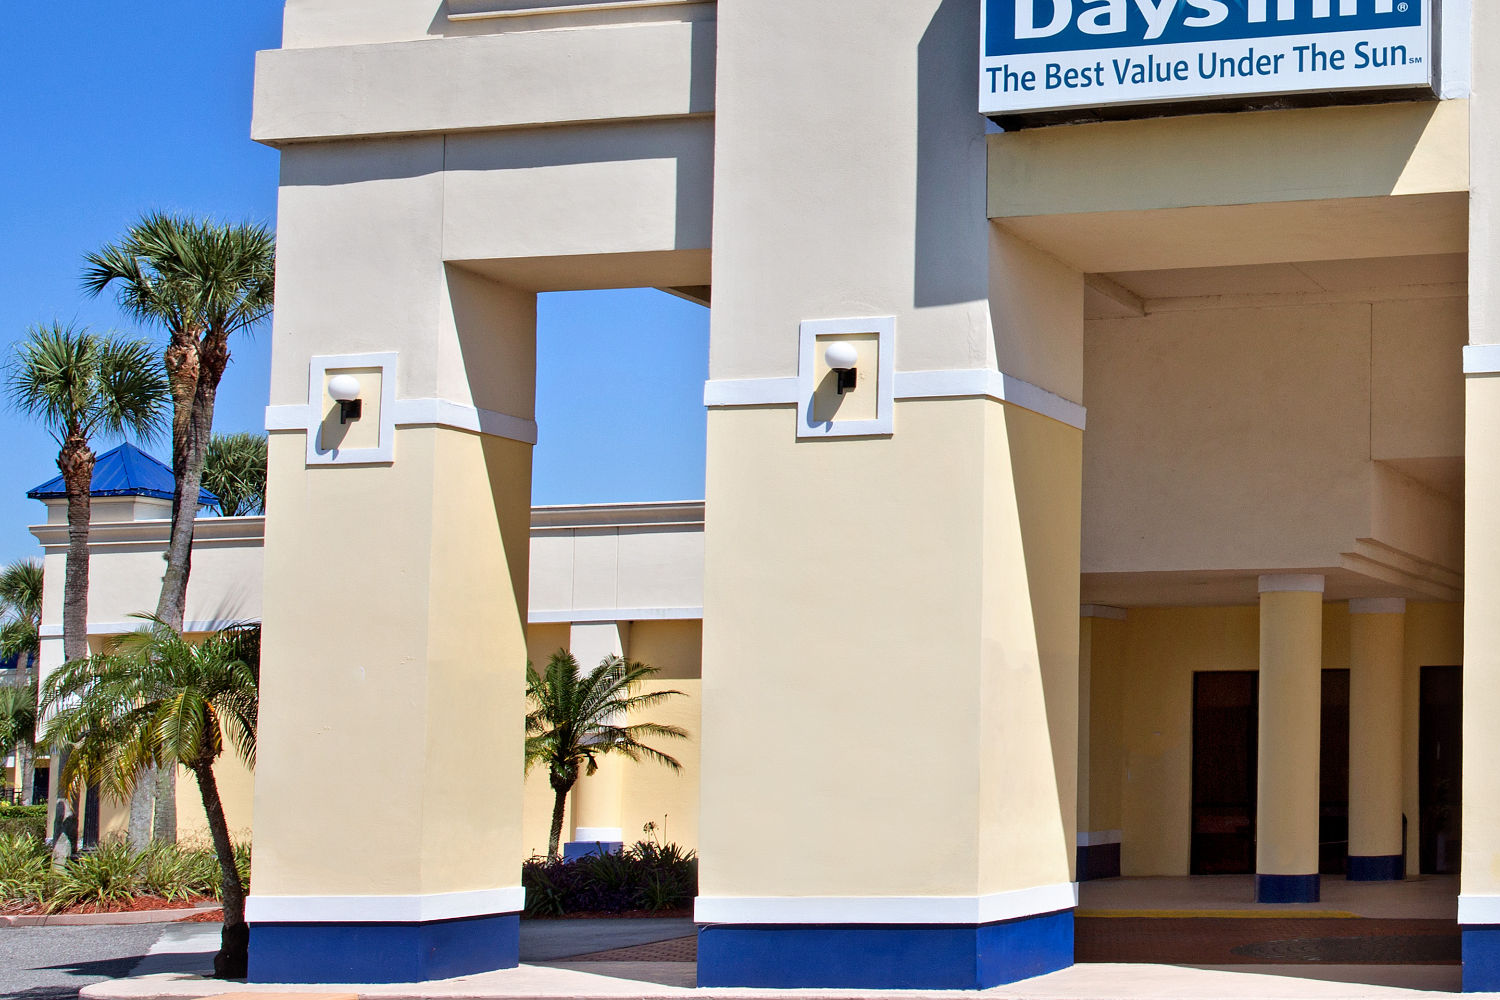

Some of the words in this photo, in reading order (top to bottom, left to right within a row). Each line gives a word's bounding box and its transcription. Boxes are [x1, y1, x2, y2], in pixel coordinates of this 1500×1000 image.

[986, 64, 1036, 93] The
[1045, 61, 1105, 89] Best
[1112, 54, 1189, 86] Value
[1198, 47, 1285, 79] Under
[1293, 42, 1345, 72] The
[1354, 40, 1407, 68] Sun
